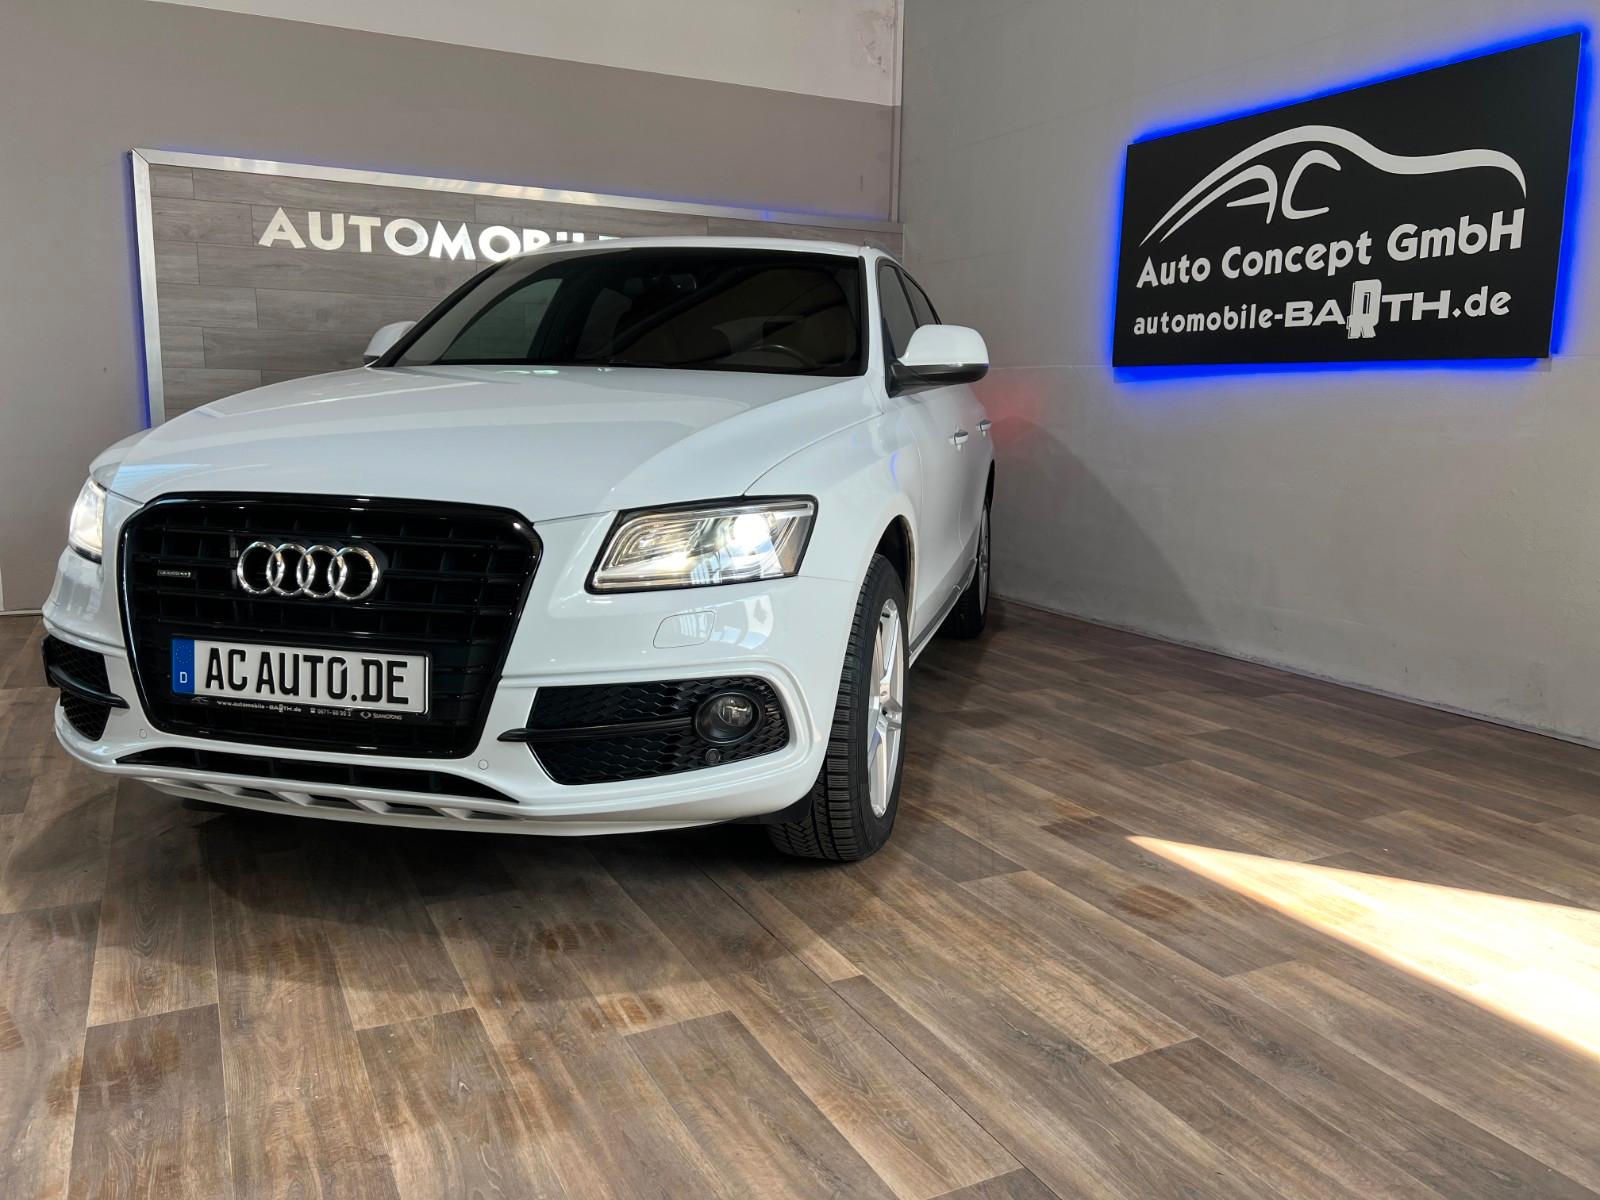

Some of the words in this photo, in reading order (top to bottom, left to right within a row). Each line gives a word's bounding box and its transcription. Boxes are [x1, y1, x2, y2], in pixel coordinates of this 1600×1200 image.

[258, 207, 622, 262] AUTOMOB
[1136, 255, 1211, 289] Auto
[1221, 231, 1372, 277] Concept
[1387, 207, 1525, 262] GmbH
[1133, 279, 1512, 340] automobile-BARTH.de
[179, 671, 188, 684] D
[205, 647, 248, 691] AC
[256, 651, 409, 705] AUTO.DE
